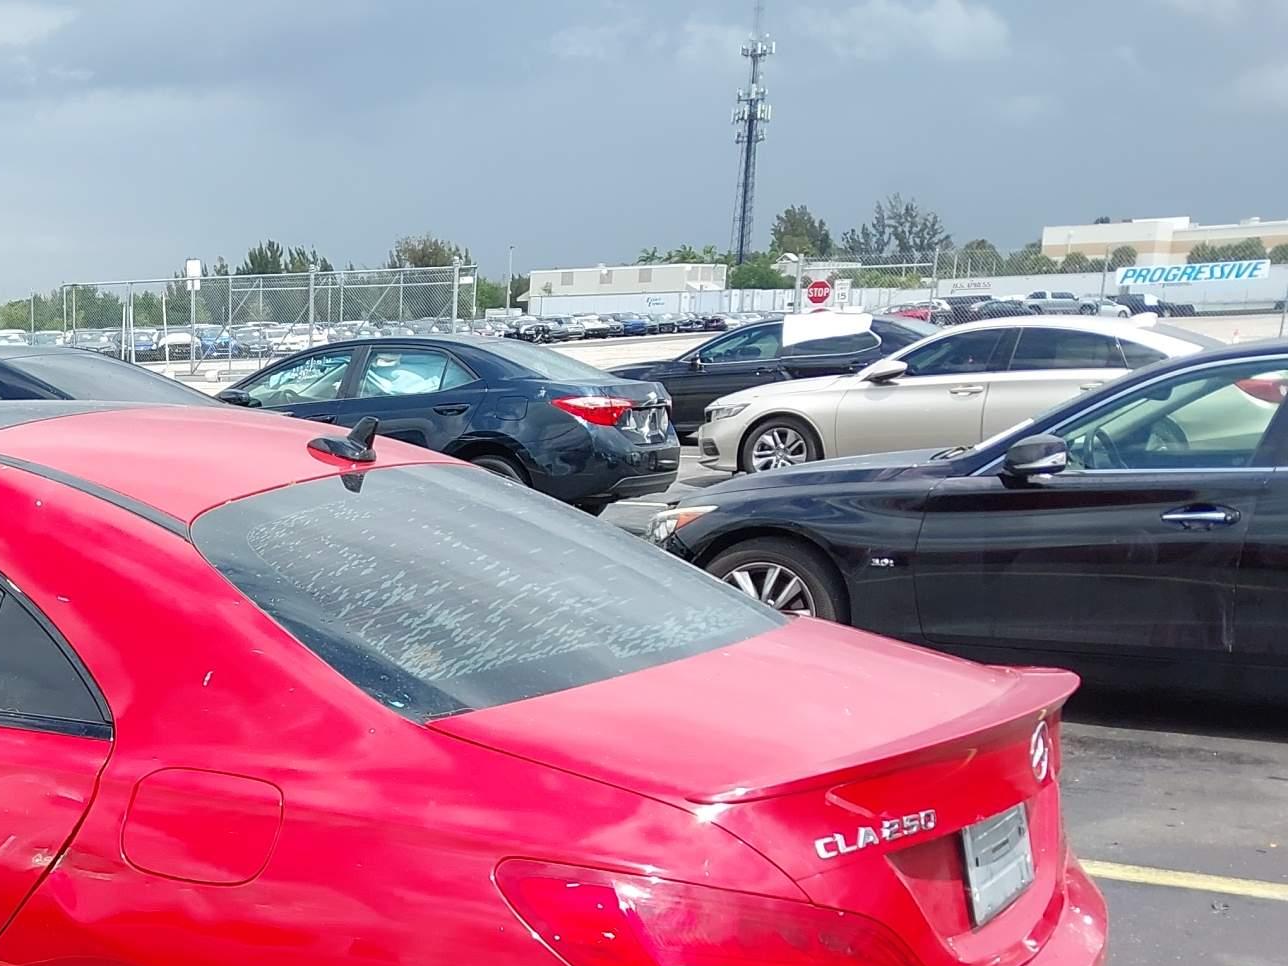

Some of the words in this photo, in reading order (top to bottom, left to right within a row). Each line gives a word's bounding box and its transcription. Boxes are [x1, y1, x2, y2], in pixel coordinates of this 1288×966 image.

[1119, 261, 1266, 284] PROGRESSIVE
[808, 287, 829, 297] STOP
[814, 826, 880, 859] CLA
[881, 808, 937, 841] 250
